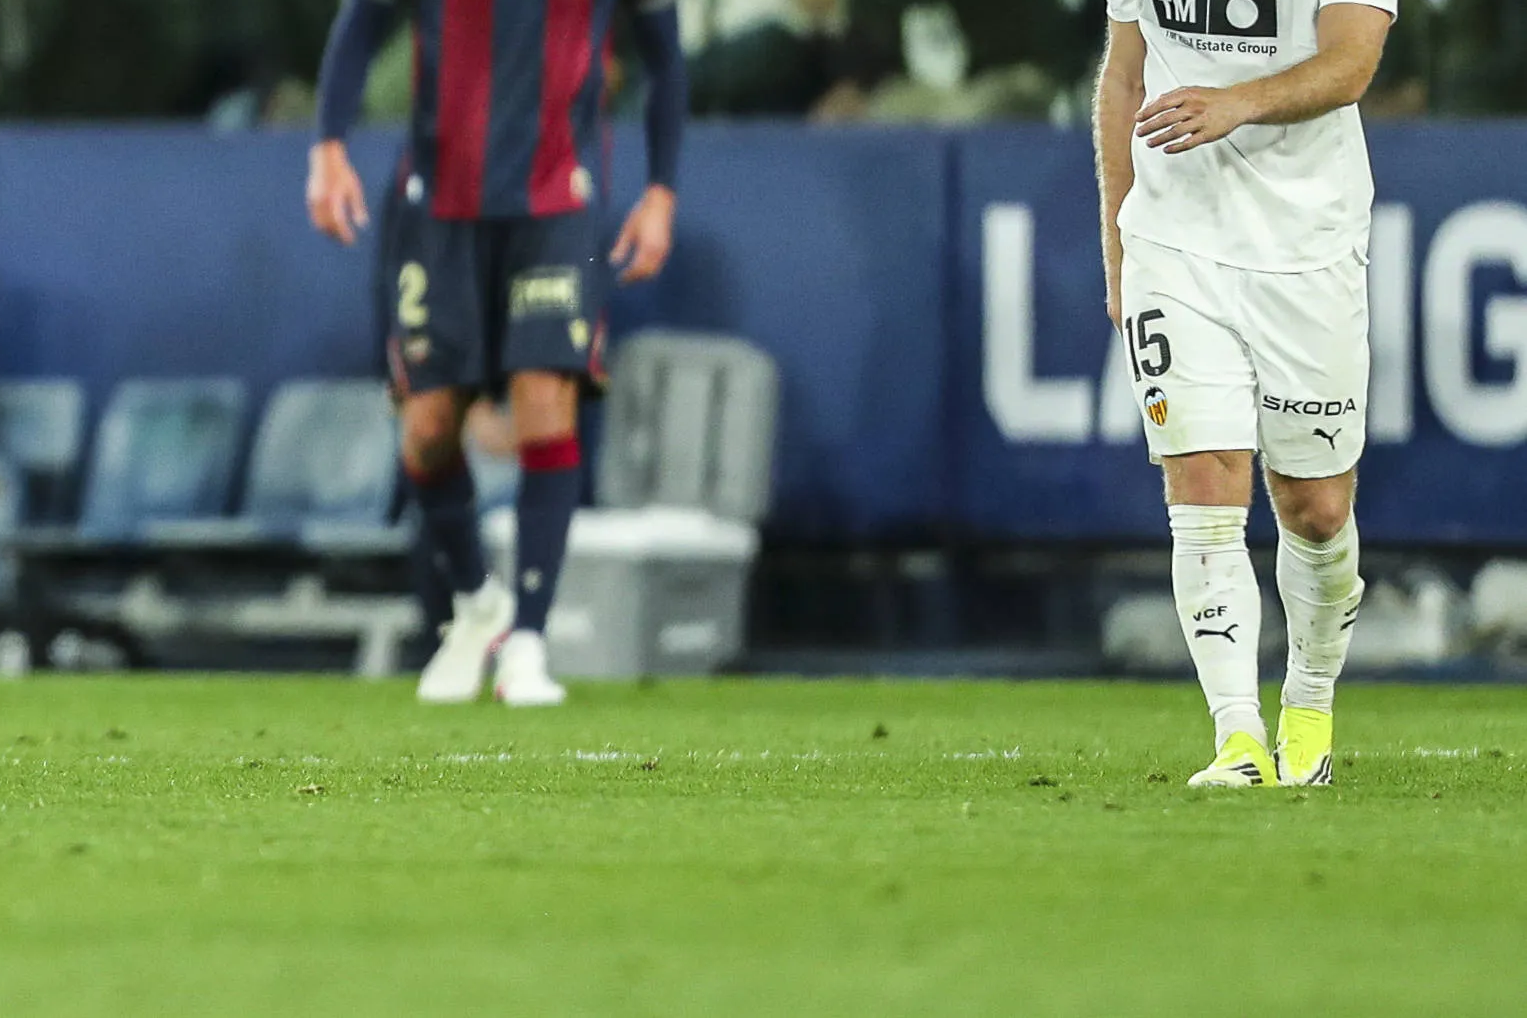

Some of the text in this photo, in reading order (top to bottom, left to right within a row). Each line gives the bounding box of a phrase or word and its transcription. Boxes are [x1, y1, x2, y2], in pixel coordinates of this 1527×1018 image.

[1195, 38, 1233, 52] Estate
[1237, 41, 1277, 57] Group
[398, 261, 429, 327] 2
[1125, 308, 1172, 383] 15
[1261, 394, 1356, 416] SKODA
[1192, 605, 1228, 622] VCF
